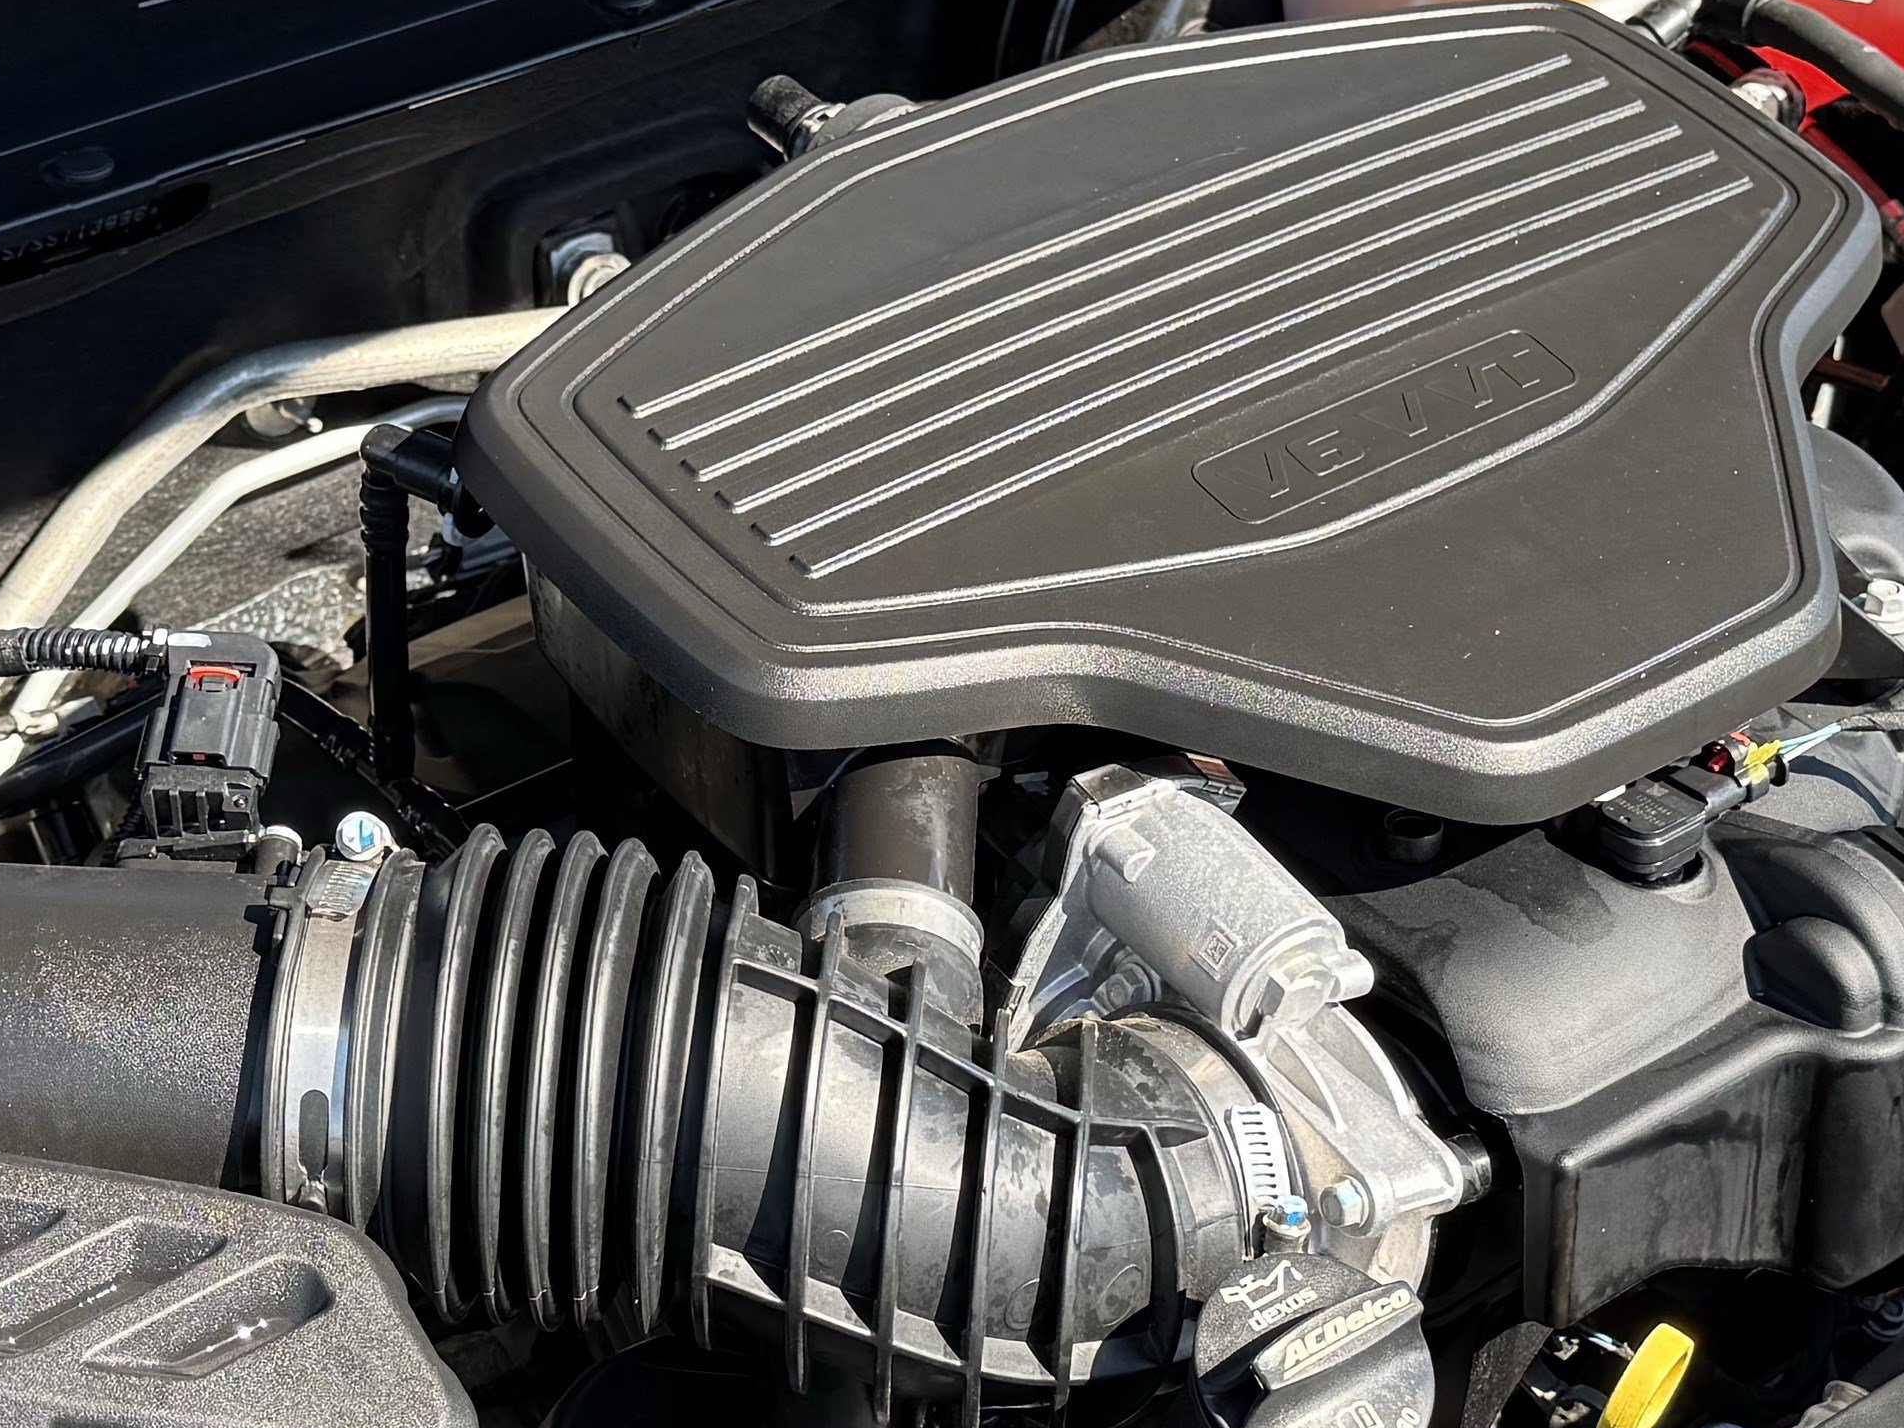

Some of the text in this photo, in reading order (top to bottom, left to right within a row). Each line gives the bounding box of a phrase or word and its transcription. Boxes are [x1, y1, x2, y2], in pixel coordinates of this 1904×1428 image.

[1214, 428, 1366, 499] V6
[1247, 1286, 1318, 1332] dexos
[1284, 1288, 1411, 1370] ACDelco
